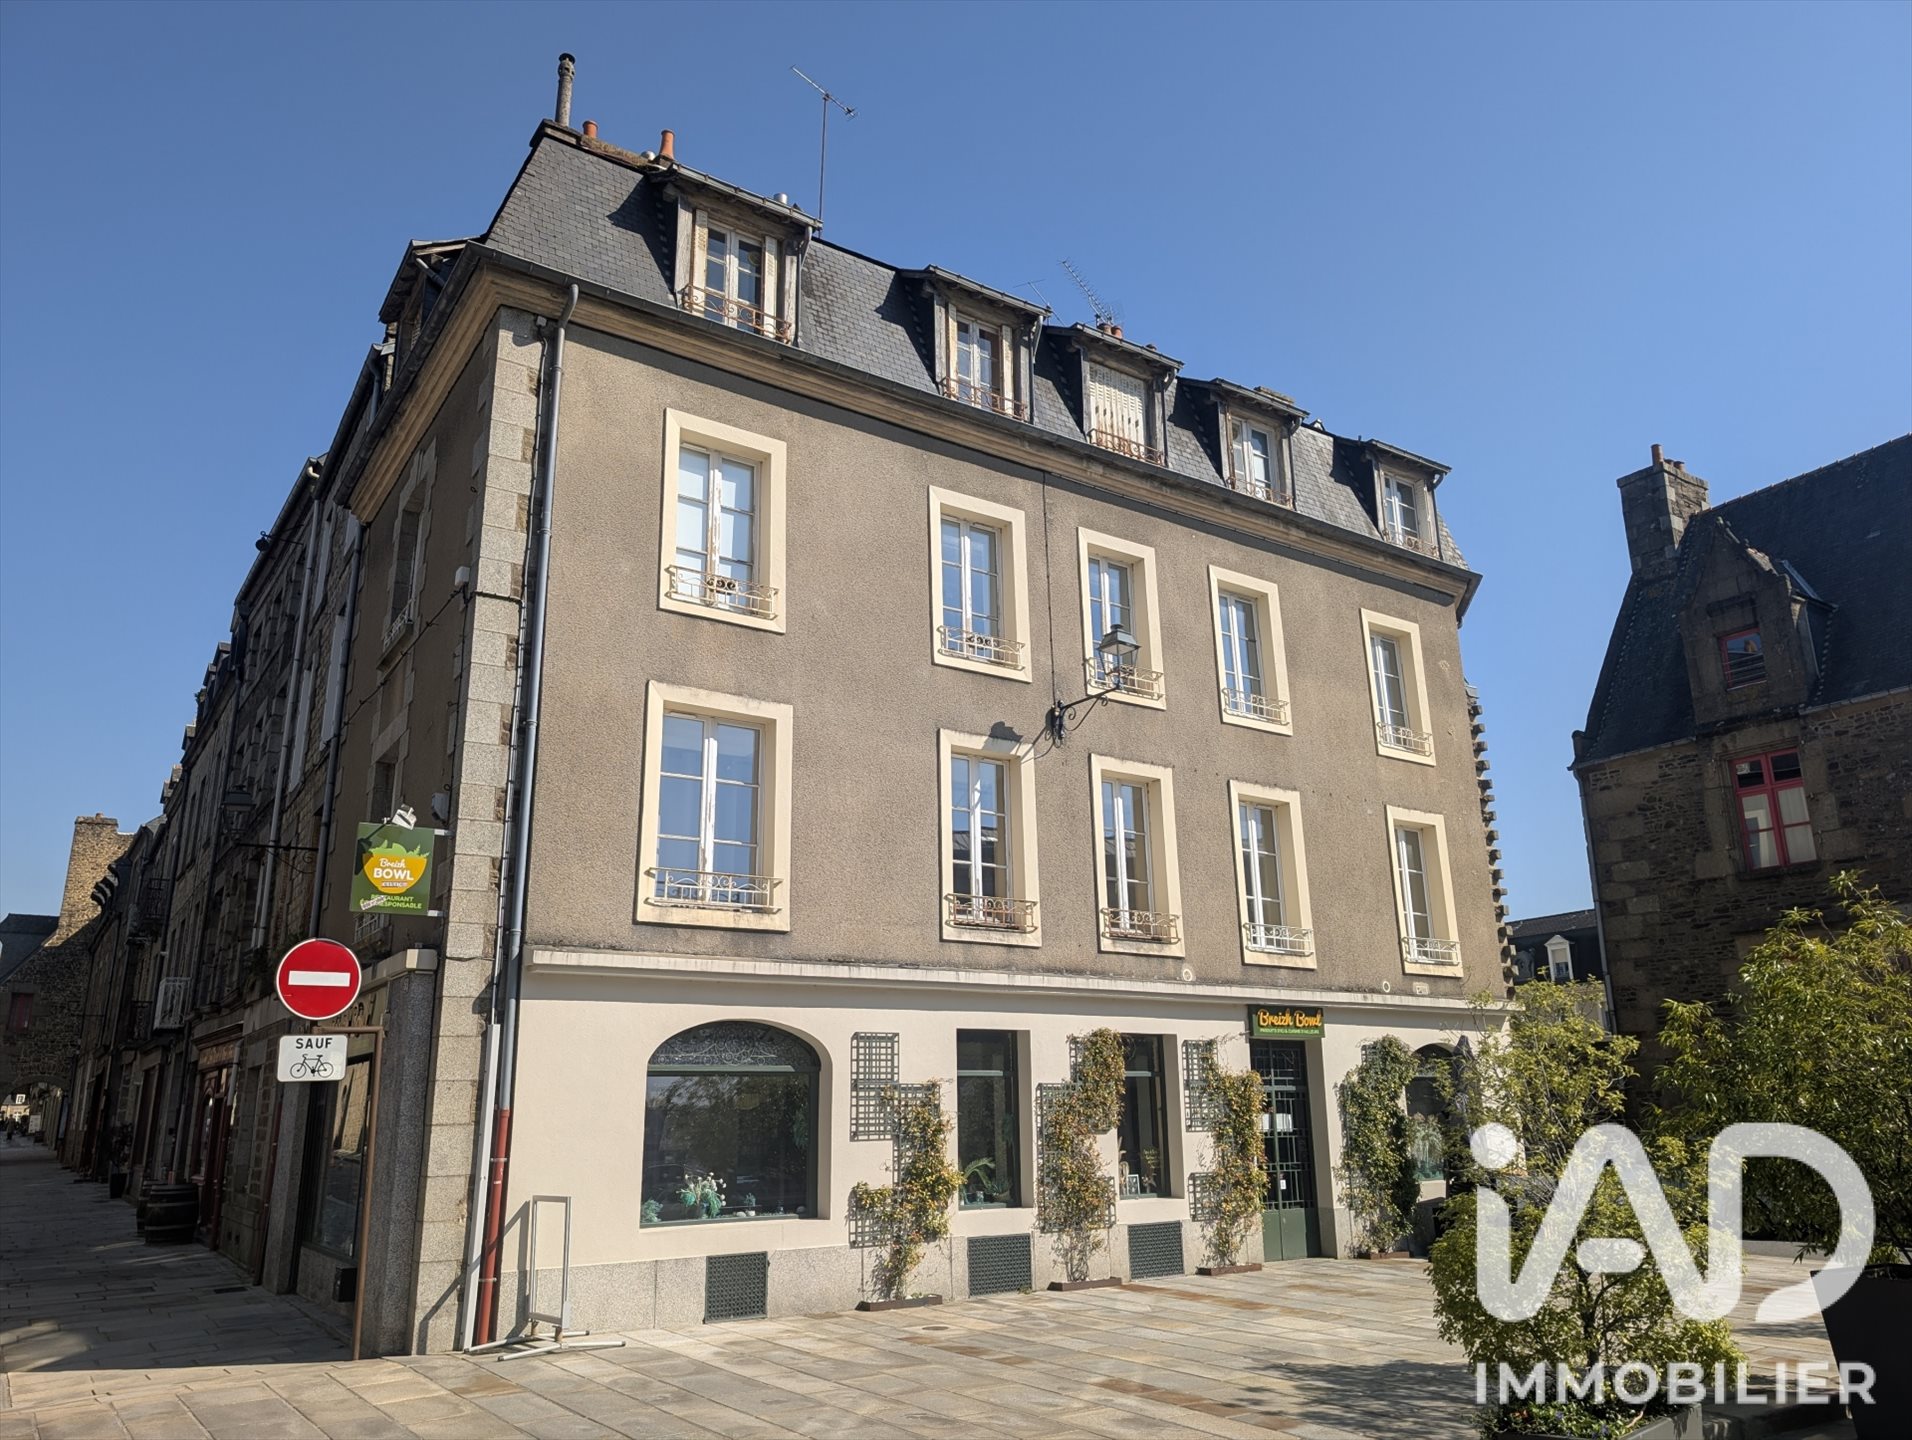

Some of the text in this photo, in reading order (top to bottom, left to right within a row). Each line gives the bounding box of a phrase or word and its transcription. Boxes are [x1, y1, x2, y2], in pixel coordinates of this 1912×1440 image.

[373, 868, 414, 880] BOWL
[1258, 1008, 1322, 1027] Breizh Bowl
[295, 1037, 333, 1049] SAUF
